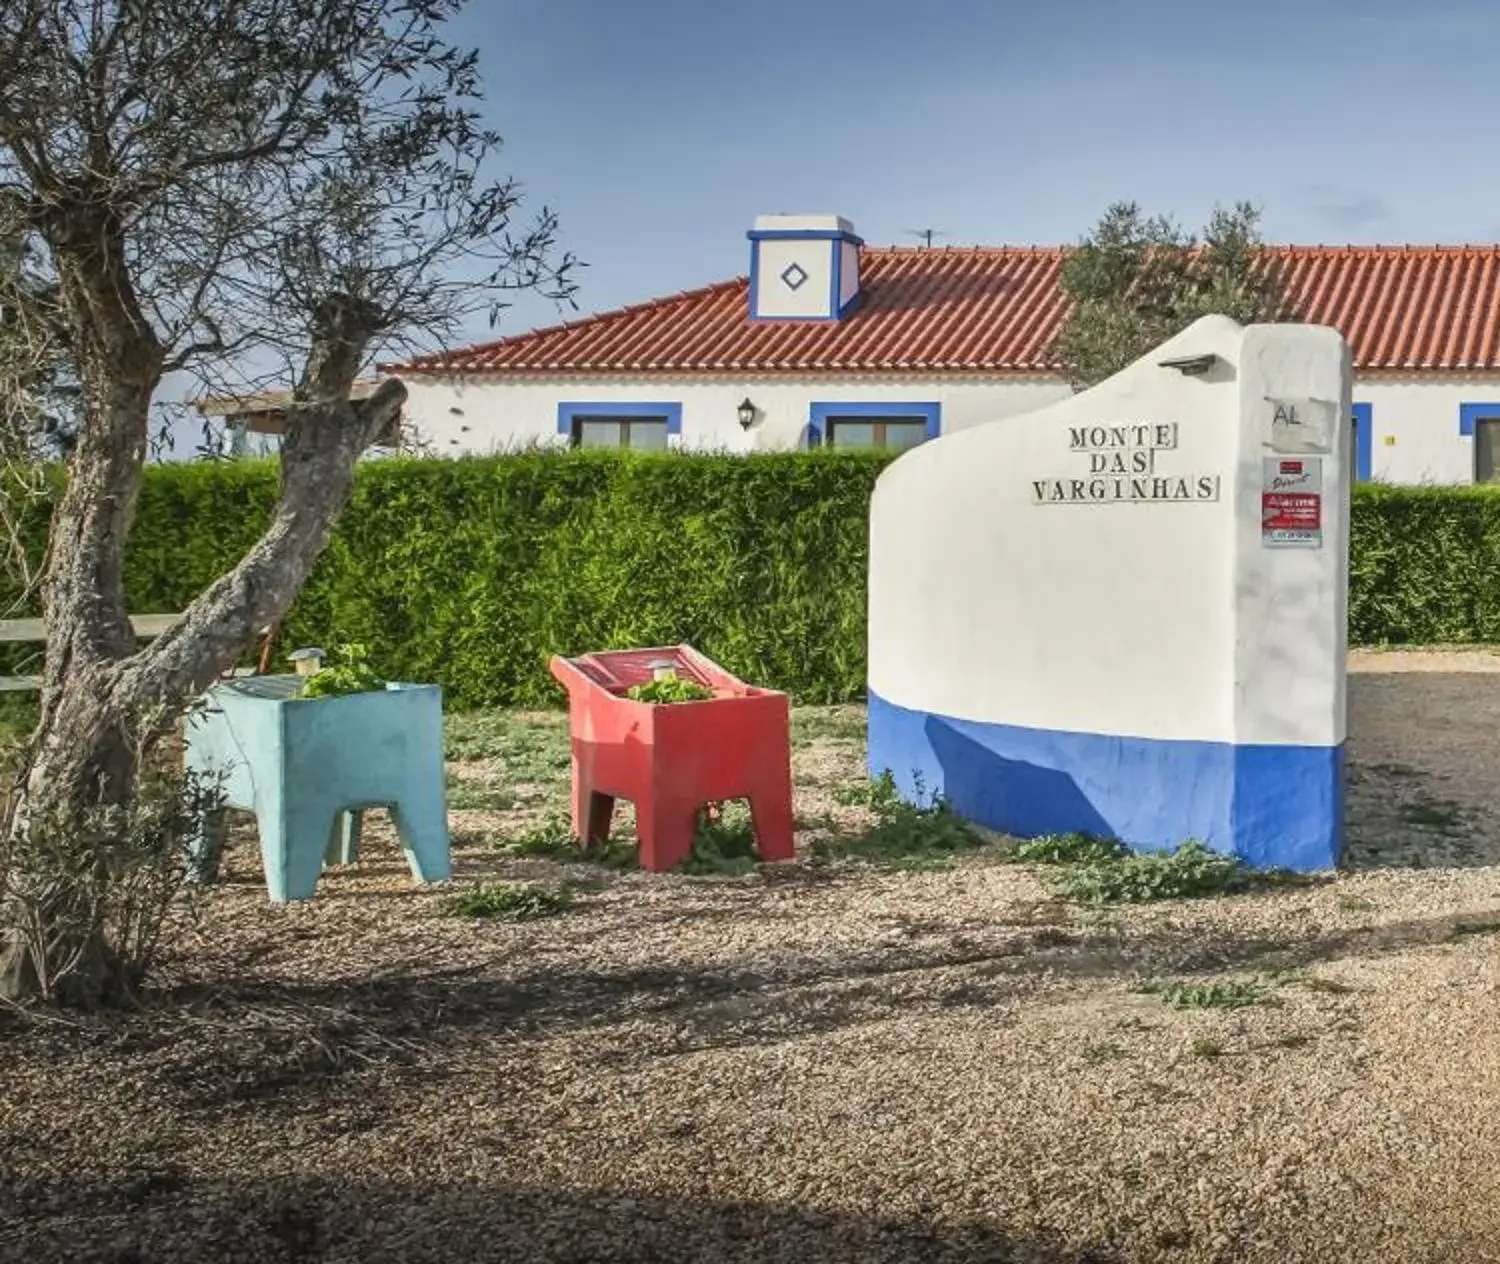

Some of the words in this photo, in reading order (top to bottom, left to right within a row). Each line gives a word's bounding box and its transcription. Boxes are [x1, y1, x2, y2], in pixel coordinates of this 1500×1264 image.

[1272, 405, 1301, 427] AL
[1069, 424, 1169, 448] MONTE
[1090, 452, 1147, 473] DAS
[1032, 476, 1212, 500] VARGINHAS
